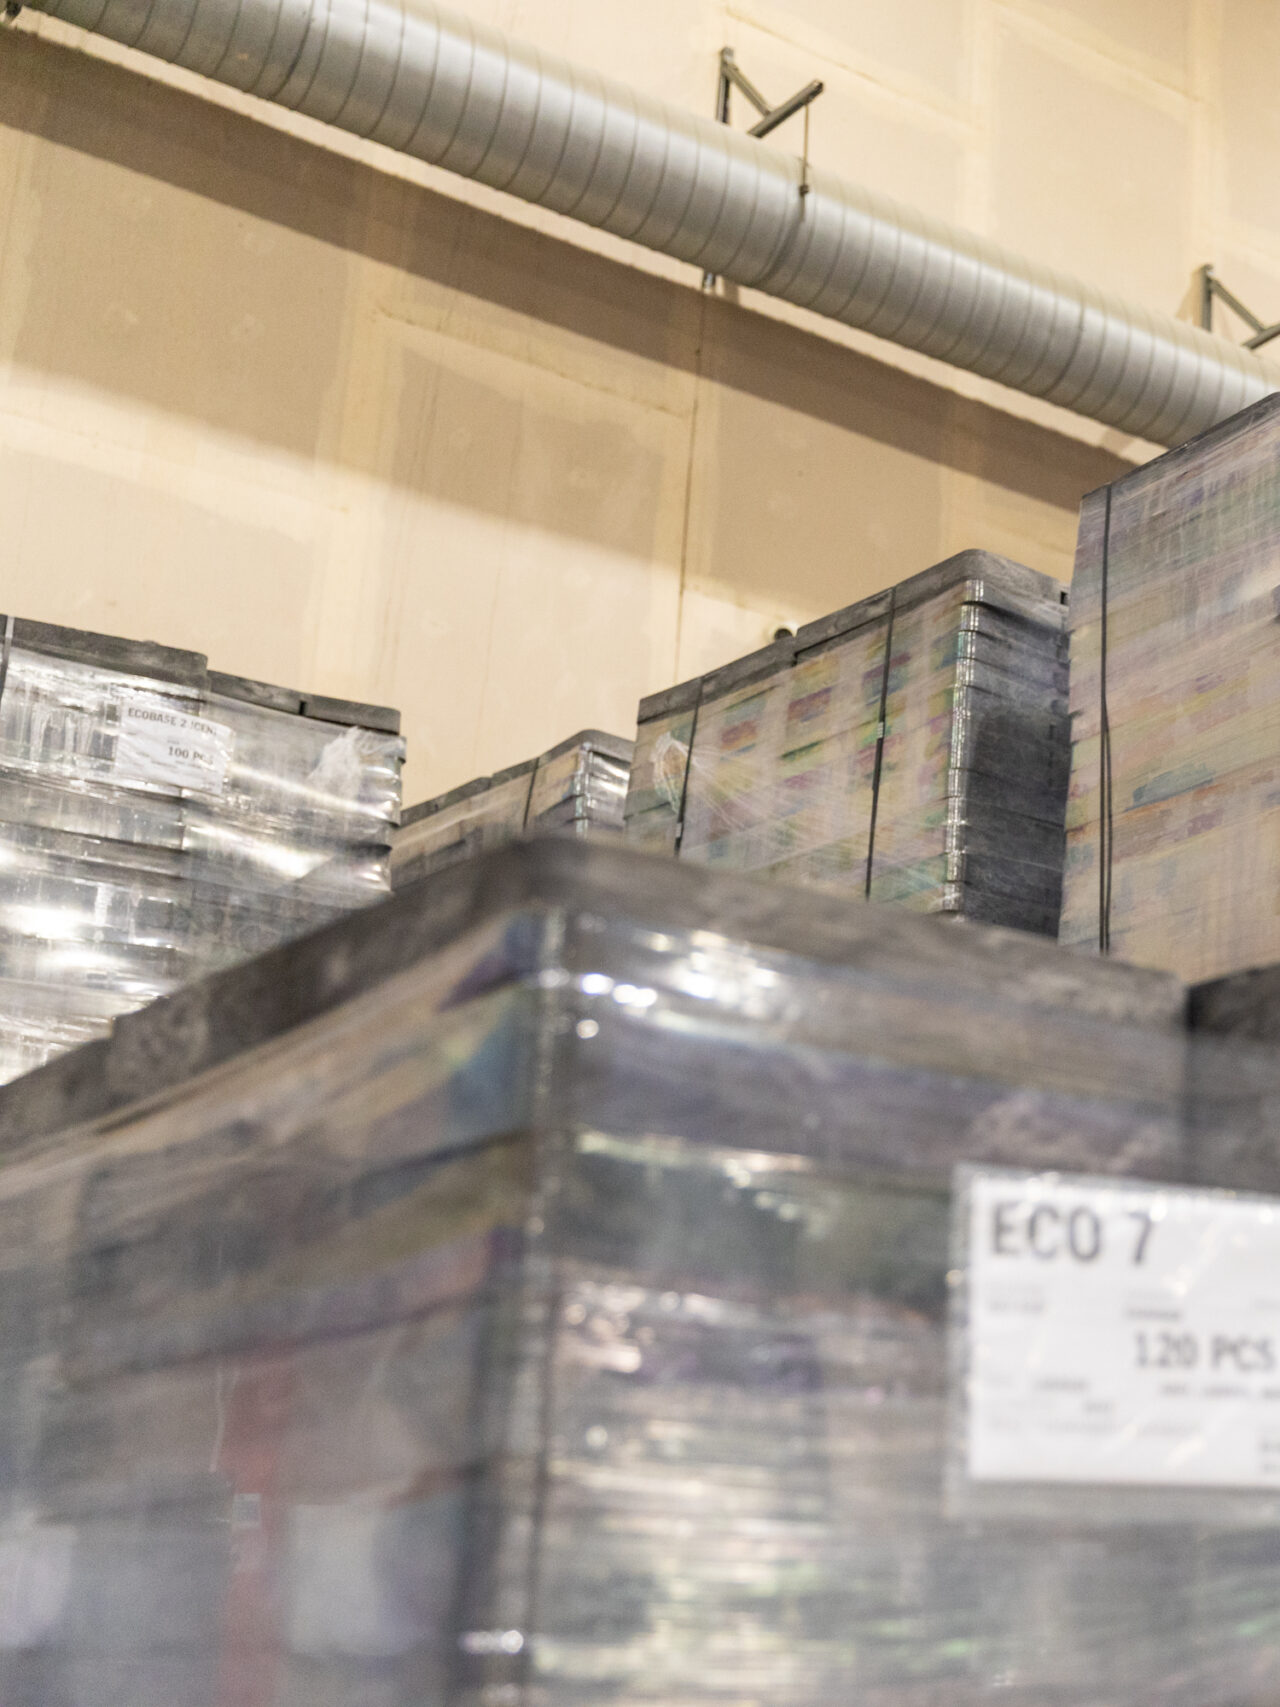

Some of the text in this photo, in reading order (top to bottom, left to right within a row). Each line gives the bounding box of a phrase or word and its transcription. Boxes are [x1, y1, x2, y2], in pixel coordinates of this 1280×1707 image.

[128, 708, 176, 727] ECOBASE
[180, 718, 187, 728] 2
[168, 746, 189, 759] 100
[991, 1204, 1156, 1267] ECO 7
[1133, 1330, 1277, 1372] 120 PCS
